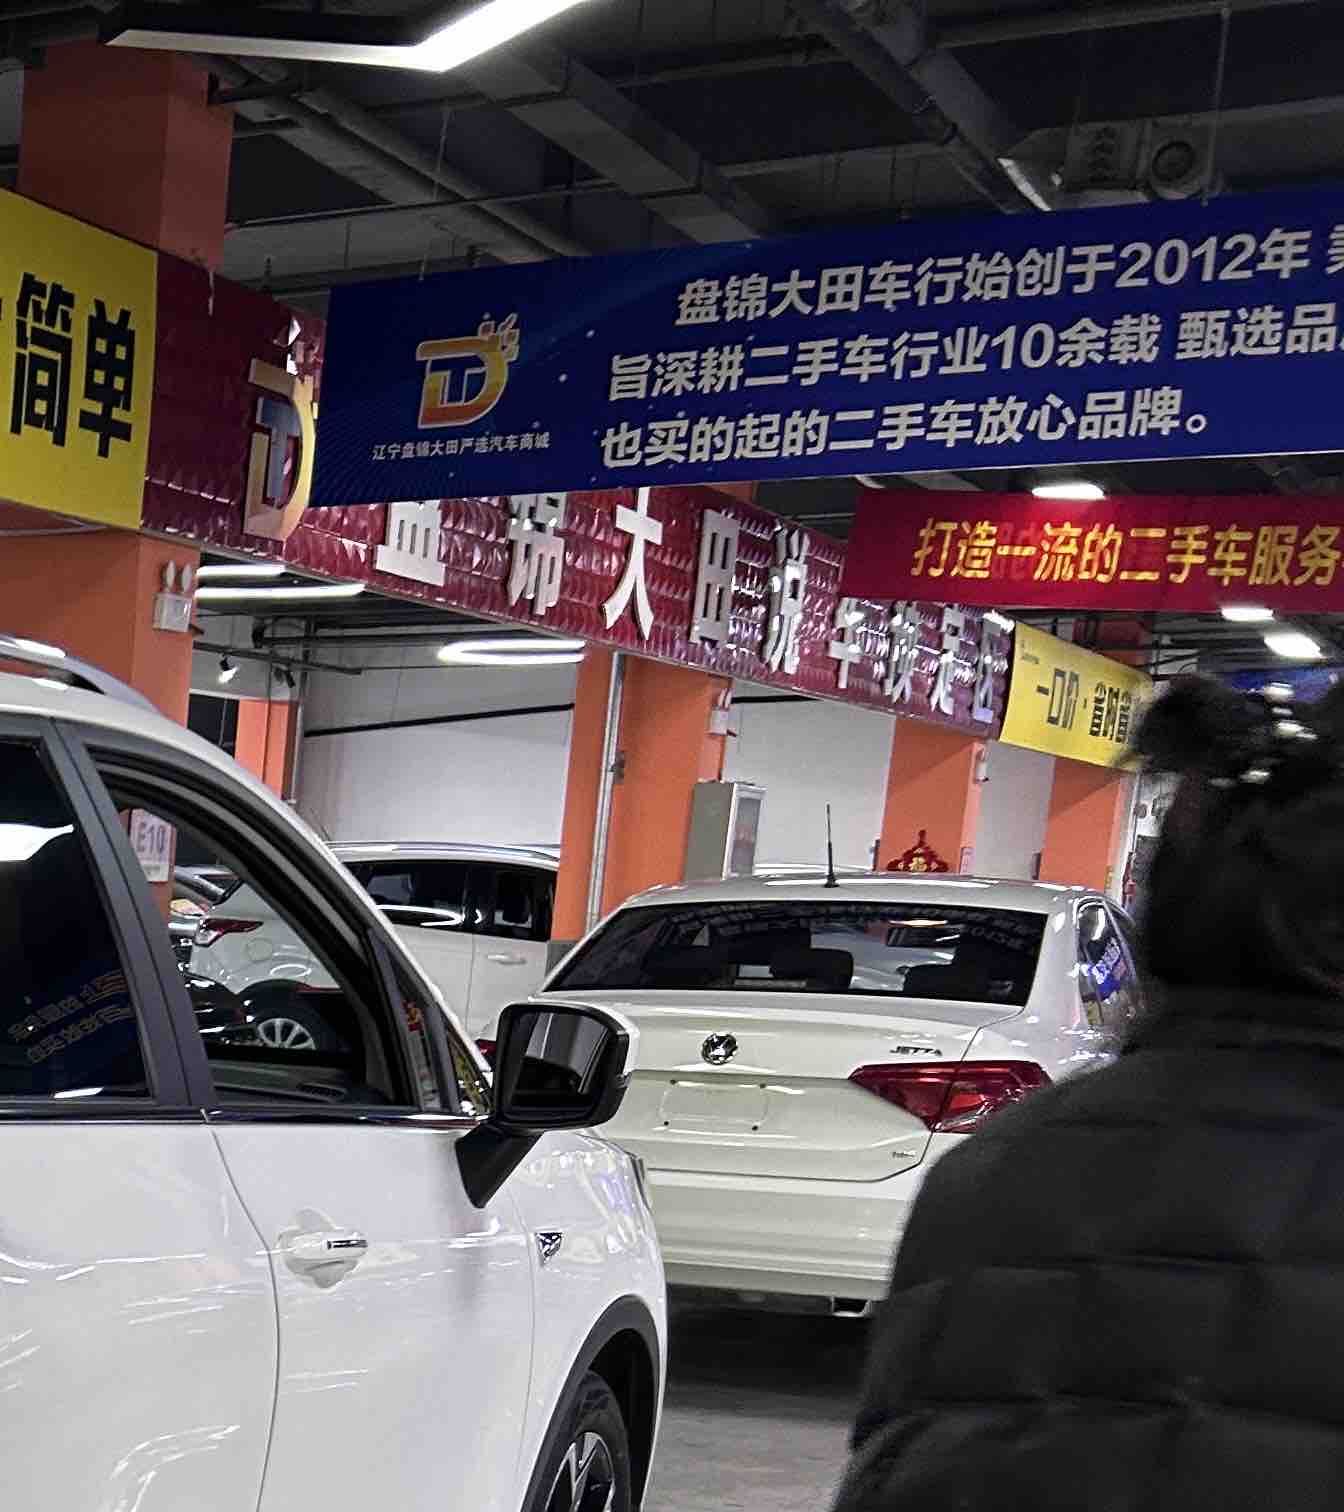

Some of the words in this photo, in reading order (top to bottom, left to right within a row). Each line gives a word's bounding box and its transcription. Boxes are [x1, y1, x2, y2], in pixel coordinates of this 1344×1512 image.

[674, 228, 1312, 327] 盘锦大田车行始创于2012年
[609, 313, 1162, 402] 旨深耕二手车行业10余载
[1174, 302, 1344, 361] 甄选品
[910, 516, 1341, 588] 打造一流的二手车服务
[889, 1045, 944, 1058] JETTA
